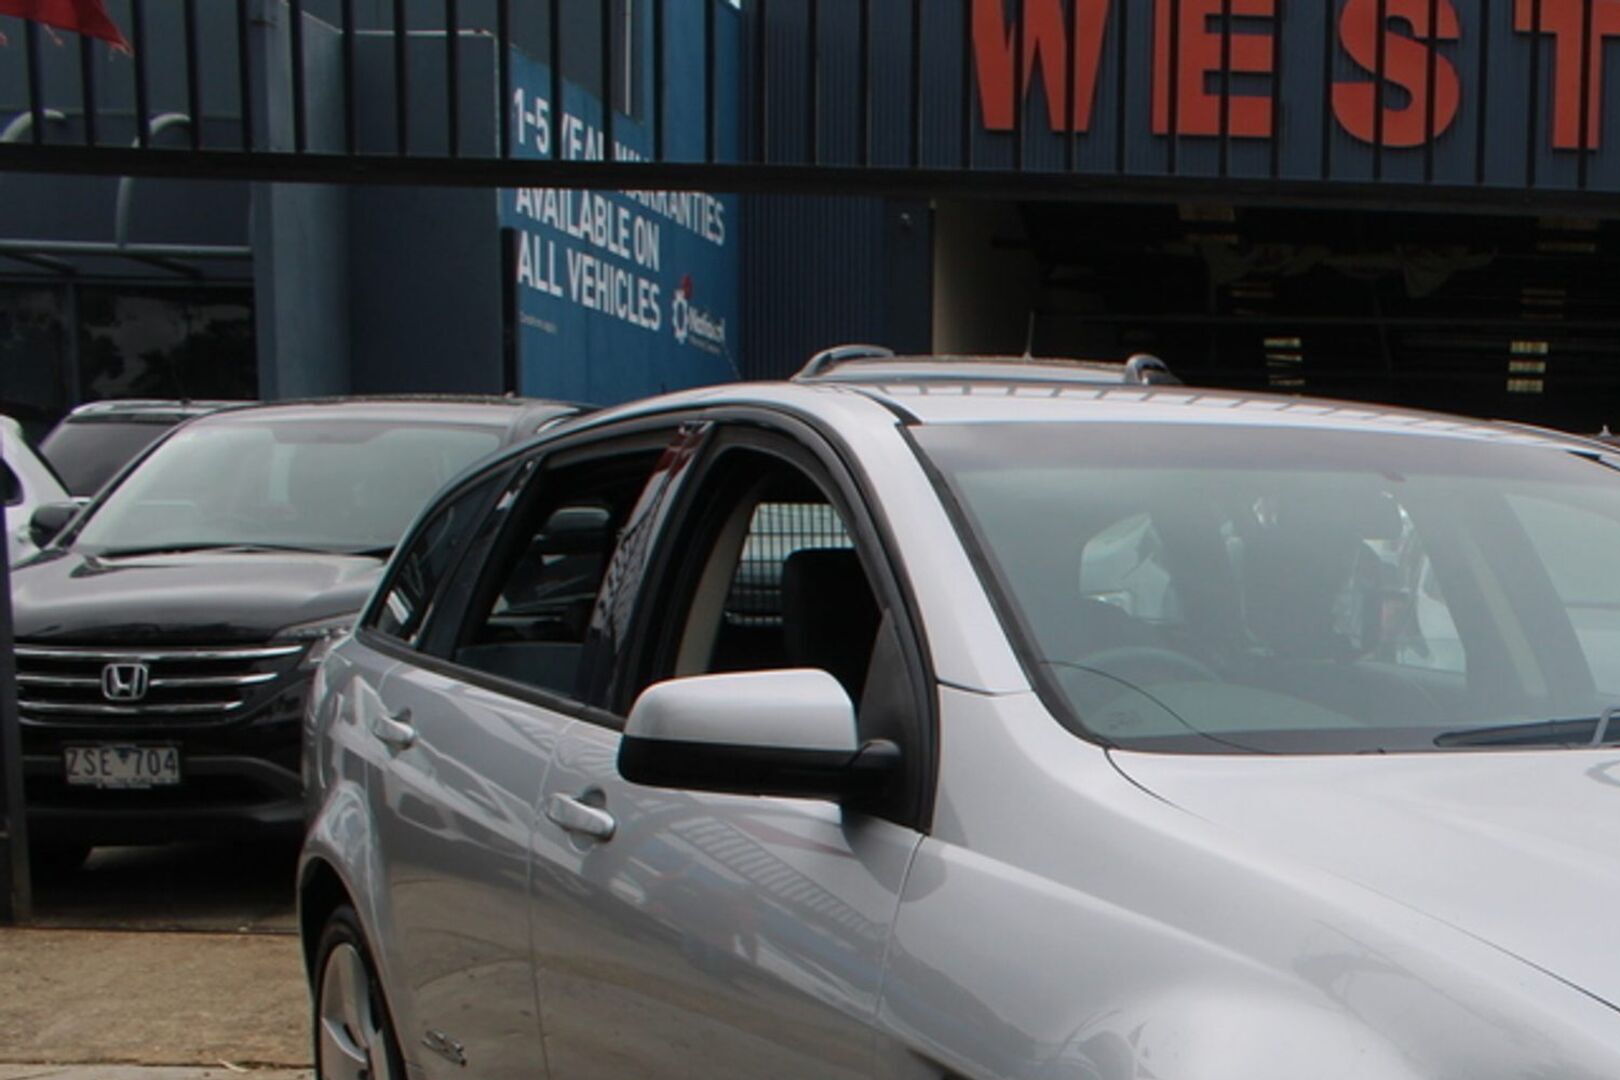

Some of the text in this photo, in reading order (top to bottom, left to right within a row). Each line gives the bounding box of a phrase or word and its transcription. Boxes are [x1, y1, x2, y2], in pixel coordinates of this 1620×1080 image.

[513, 88, 549, 154] 1-5
[634, 215, 659, 272] ON
[517, 230, 661, 332] ALL VEHICLES
[133, 748, 177, 777] 704
